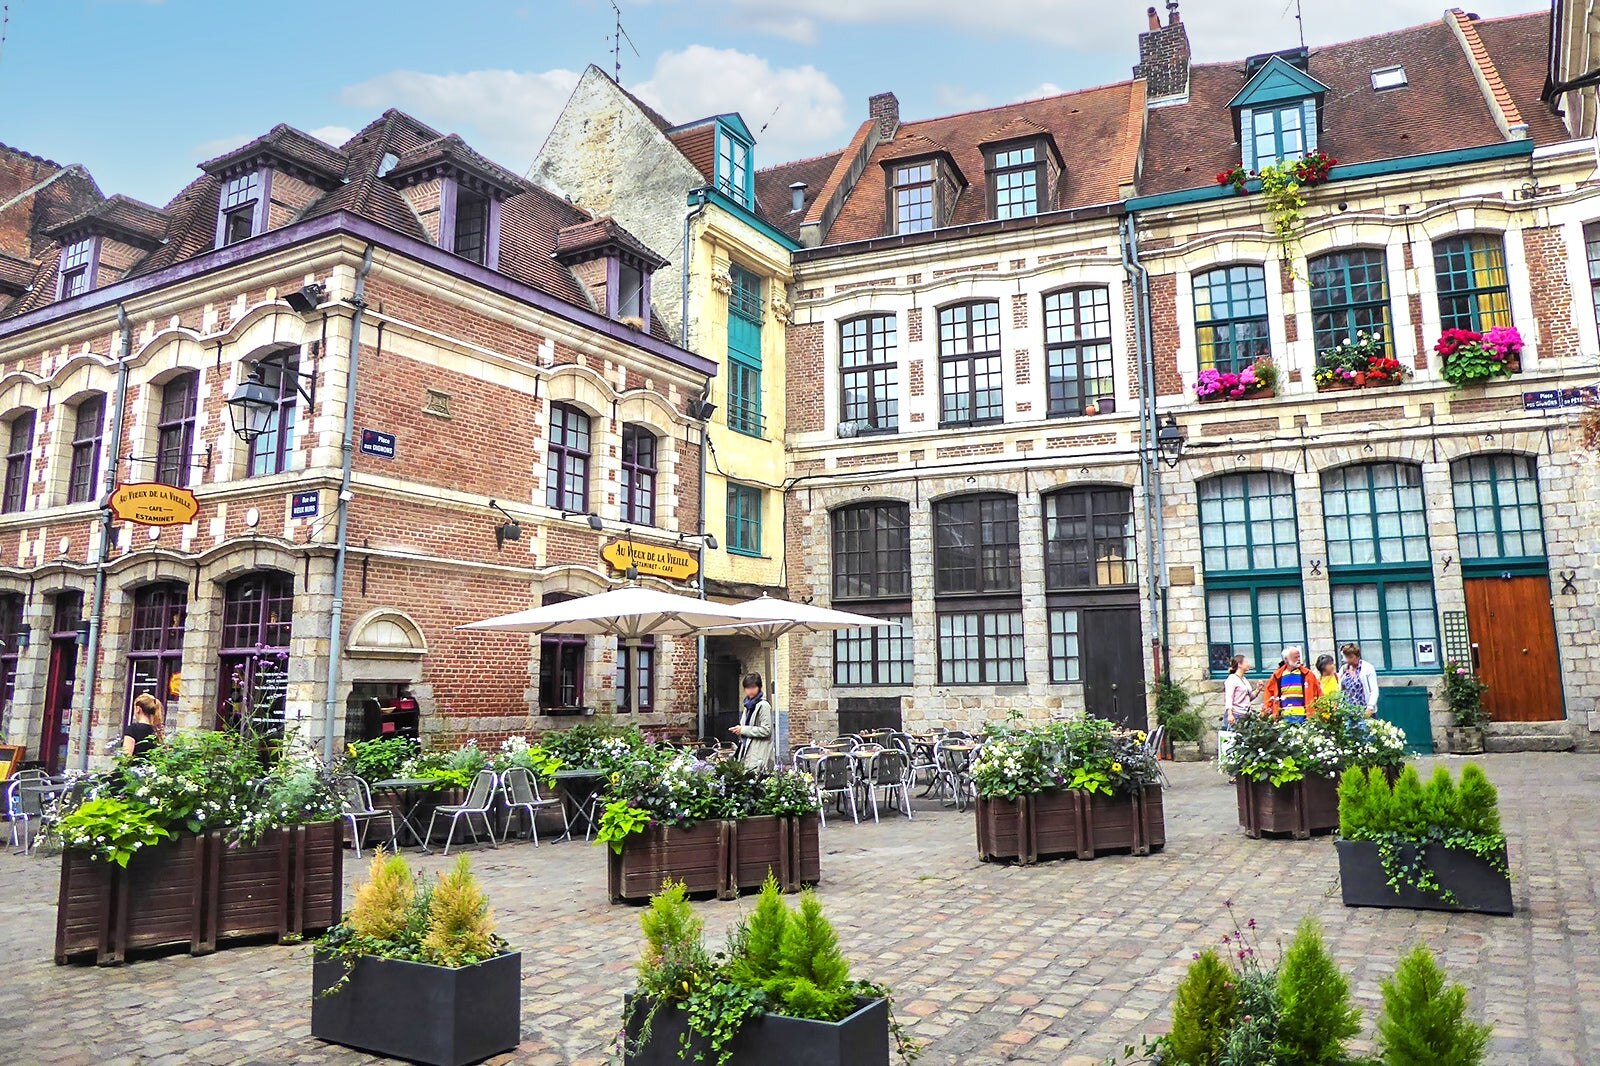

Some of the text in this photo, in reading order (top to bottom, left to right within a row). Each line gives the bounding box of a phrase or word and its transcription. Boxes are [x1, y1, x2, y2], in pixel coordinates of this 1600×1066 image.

[378, 435, 391, 445] Place
[372, 444, 393, 454] OIGNONS
[149, 490, 158, 498] DE
[160, 491, 168, 499] LA
[136, 513, 175, 522] ESTAMINET
[647, 551, 655, 562] DE
[657, 554, 665, 562] LA
[667, 552, 689, 567] VIEILLE
